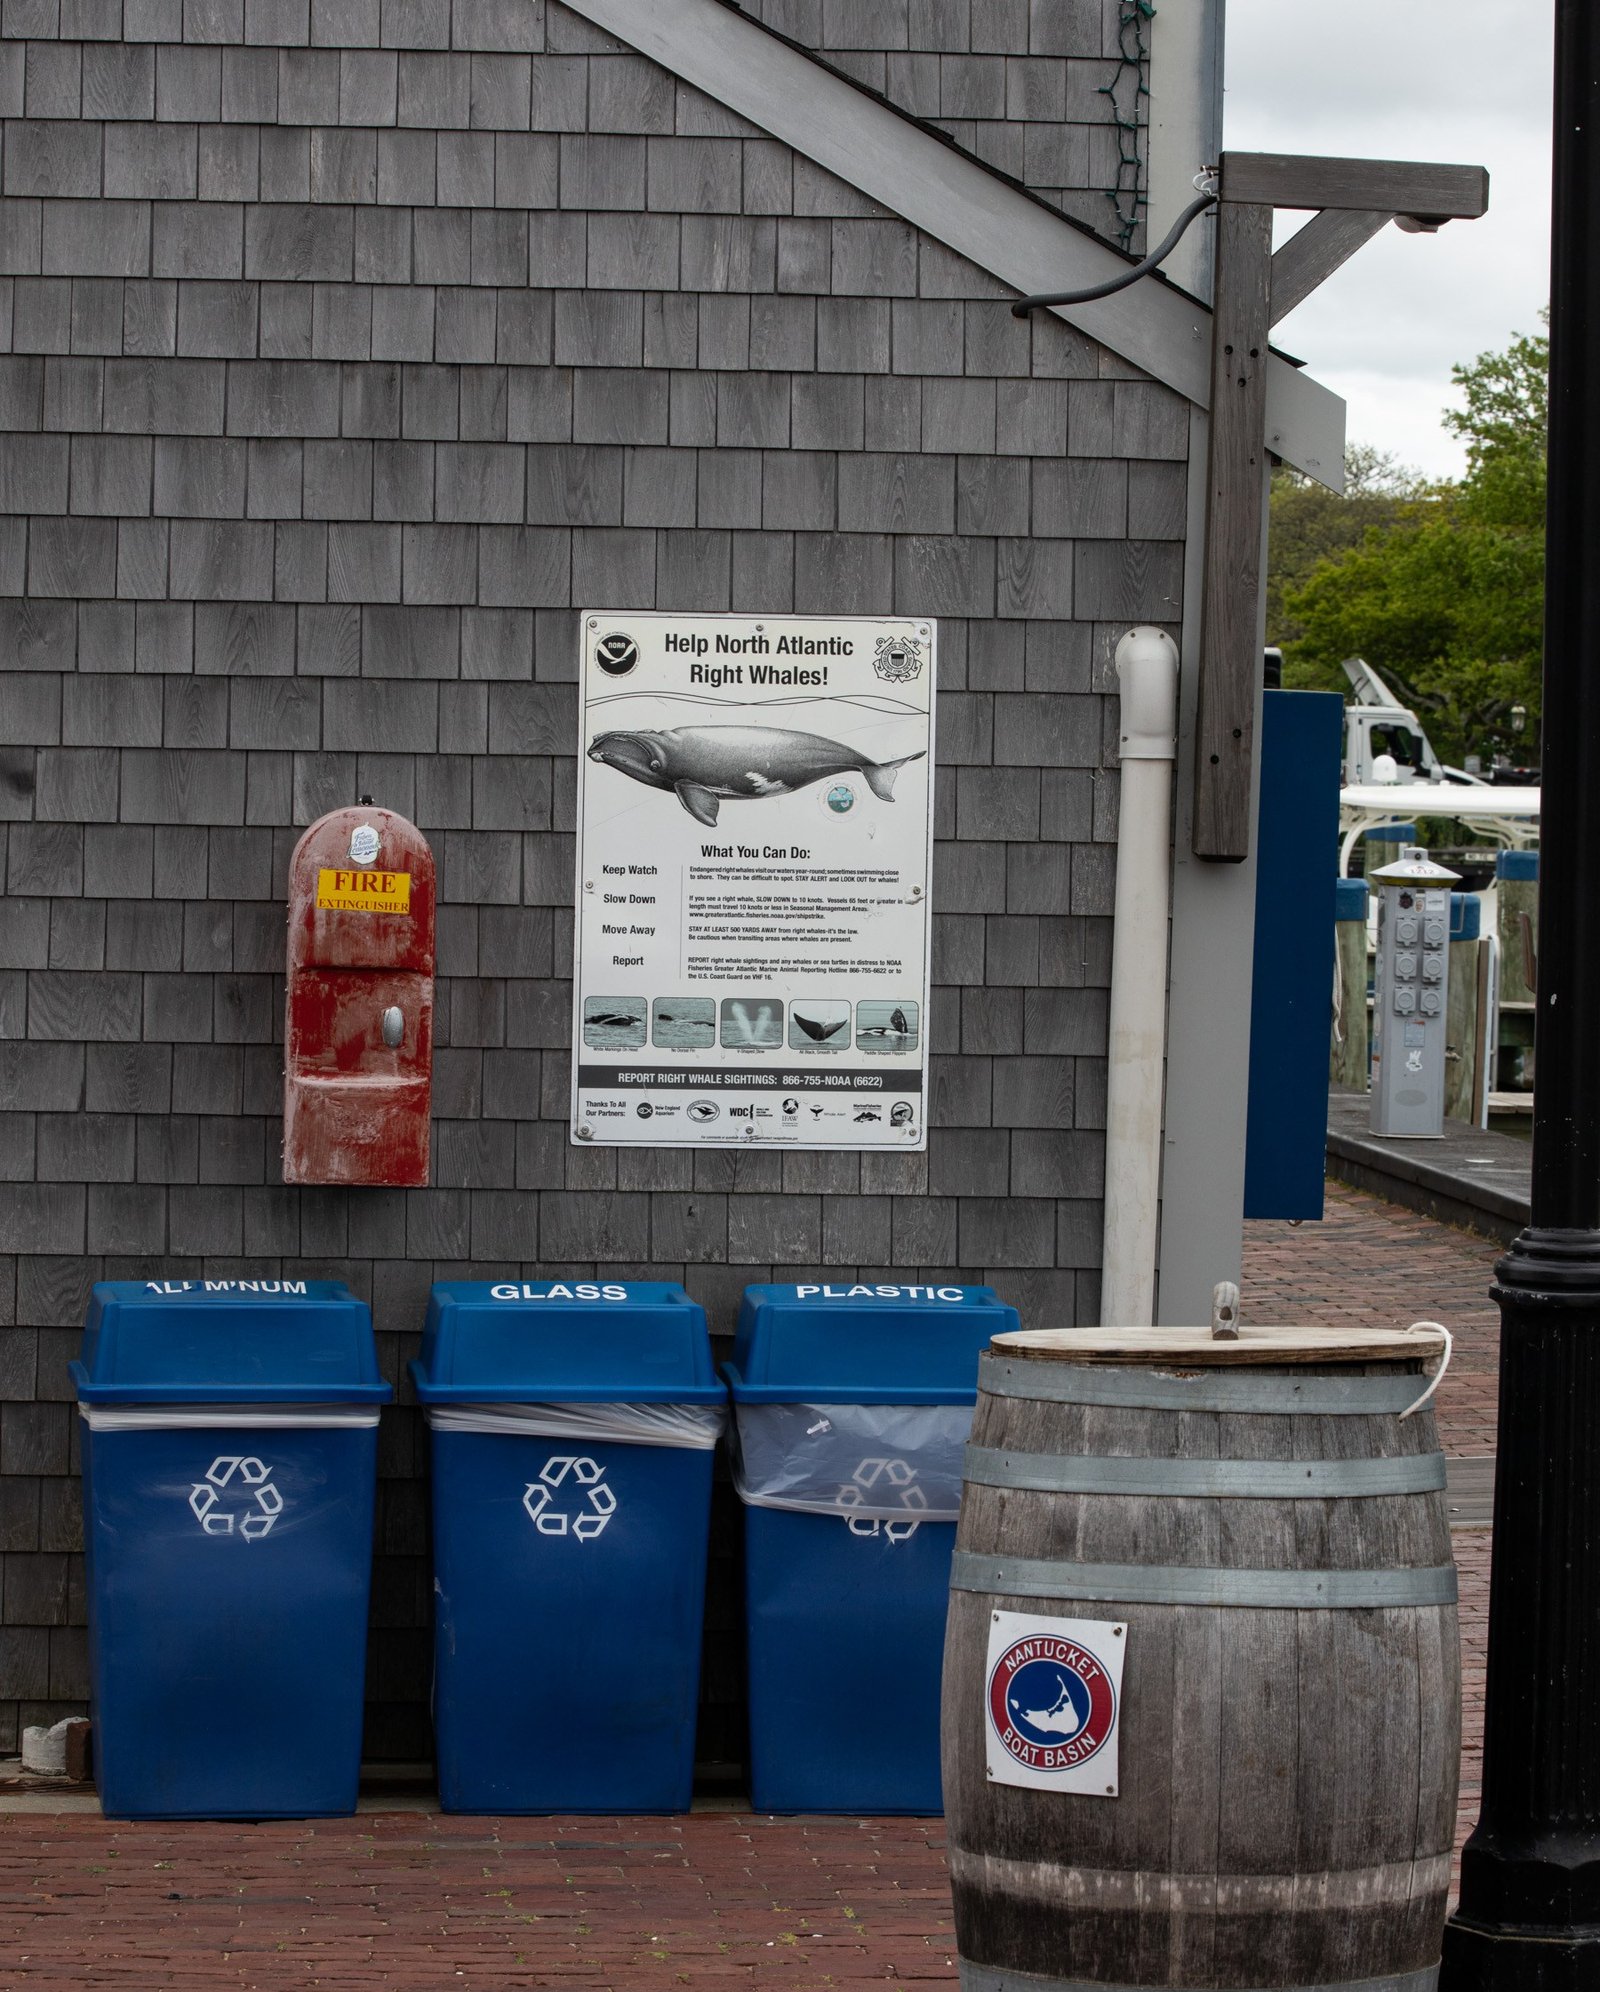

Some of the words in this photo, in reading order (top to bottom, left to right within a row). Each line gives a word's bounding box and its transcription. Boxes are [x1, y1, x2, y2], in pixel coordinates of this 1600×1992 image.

[665, 634, 708, 656] Help
[716, 635, 769, 654] North
[776, 636, 853, 655] Atlantic
[690, 664, 743, 687] Right
[750, 666, 828, 685] Whales!
[701, 845, 733, 857] What
[737, 846, 758, 857] You
[763, 846, 786, 858] Can
[791, 847, 810, 858] Do:
[603, 865, 625, 876] Keep
[628, 865, 657, 874] Watch
[333, 872, 396, 893] FIRE
[319, 899, 408, 911] EXTINGUISHER
[603, 894, 626, 903] Slow
[630, 894, 656, 904] Down
[602, 924, 627, 934] Move
[630, 925, 655, 936] Away
[613, 956, 644, 967] Report
[618, 1073, 655, 1082] REPORT
[658, 1073, 686, 1083] RIGHT
[688, 1074, 722, 1084] WHALE
[724, 1074, 777, 1084] SIGHTINGS:
[782, 1076, 851, 1085] 866-755-NOAA
[854, 1076, 883, 1087] (6622)
[730, 1108, 749, 1116] WDC
[491, 1284, 627, 1300] GLASS
[796, 1285, 963, 1301] PLASTIC
[1005, 1640, 1100, 1681] NANTUCKET
[1003, 1727, 1039, 1764] BOAT
[1044, 1732, 1097, 1767] BASIN
